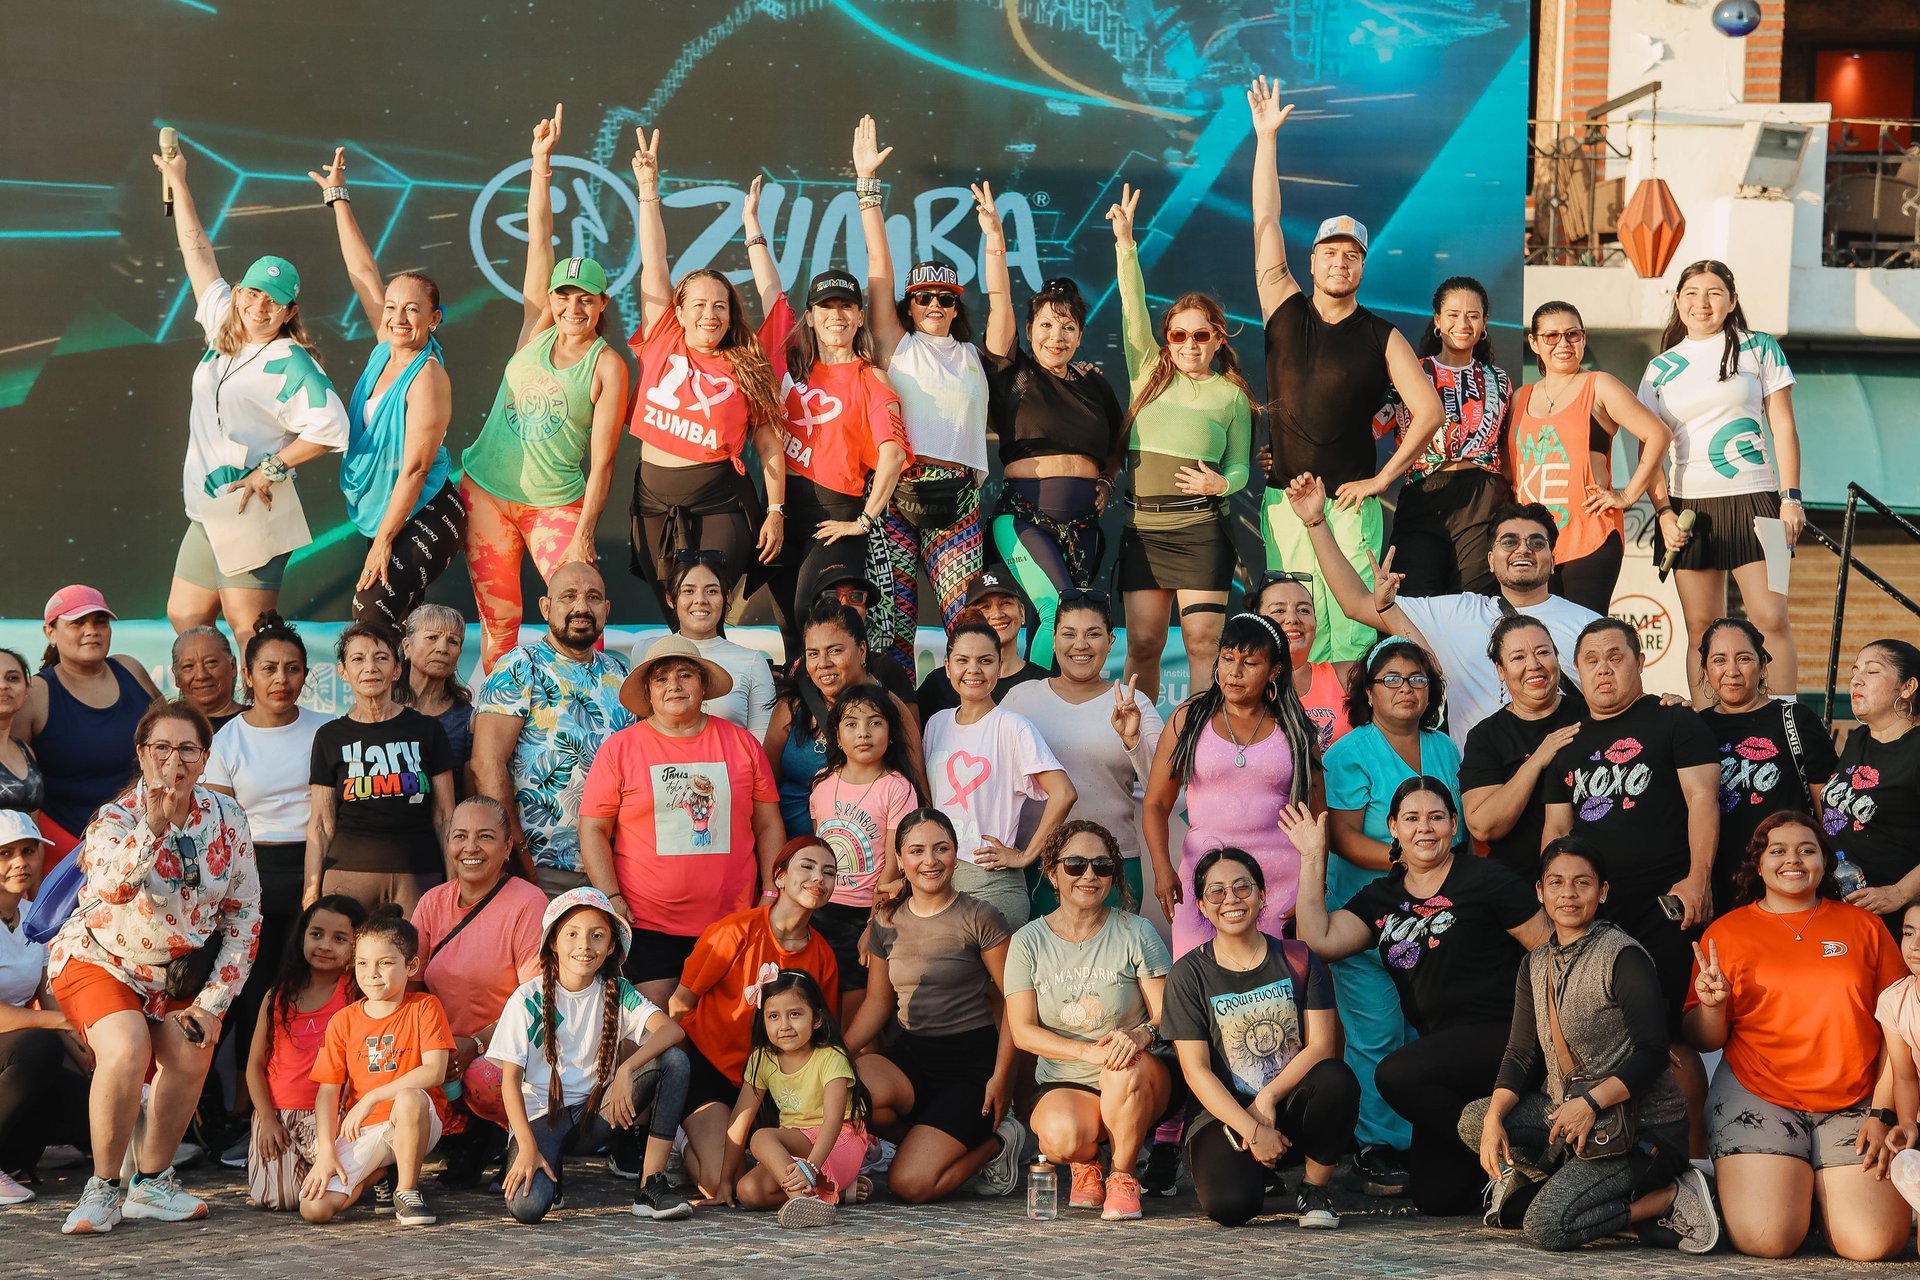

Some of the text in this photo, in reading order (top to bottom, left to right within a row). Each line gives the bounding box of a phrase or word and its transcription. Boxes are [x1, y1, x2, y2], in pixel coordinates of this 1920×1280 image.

[816, 278, 855, 292] ZUMBA
[643, 404, 718, 450] ZUMBA
[1516, 424, 1569, 465] WA
[1518, 463, 1570, 504] KE
[897, 498, 948, 515] ZUMBA
[441, 514, 459, 539] bebe
[411, 535, 433, 560] bebe
[982, 574, 999, 587] LA
[1163, 669, 1191, 678] Institu
[1305, 708, 1337, 720] PORTS
[1784, 708, 1801, 755] BIMBA
[343, 771, 431, 801] ZUMBA
[1573, 763, 1653, 804] XOXO
[1720, 757, 1782, 792] OXO
[844, 803, 881, 840] RAINBOW
[1379, 911, 1457, 946] XOXO
[1066, 982, 1096, 992] MARKET
[1254, 984, 1294, 1002] EVOLVE
[366, 1034, 398, 1073] H
